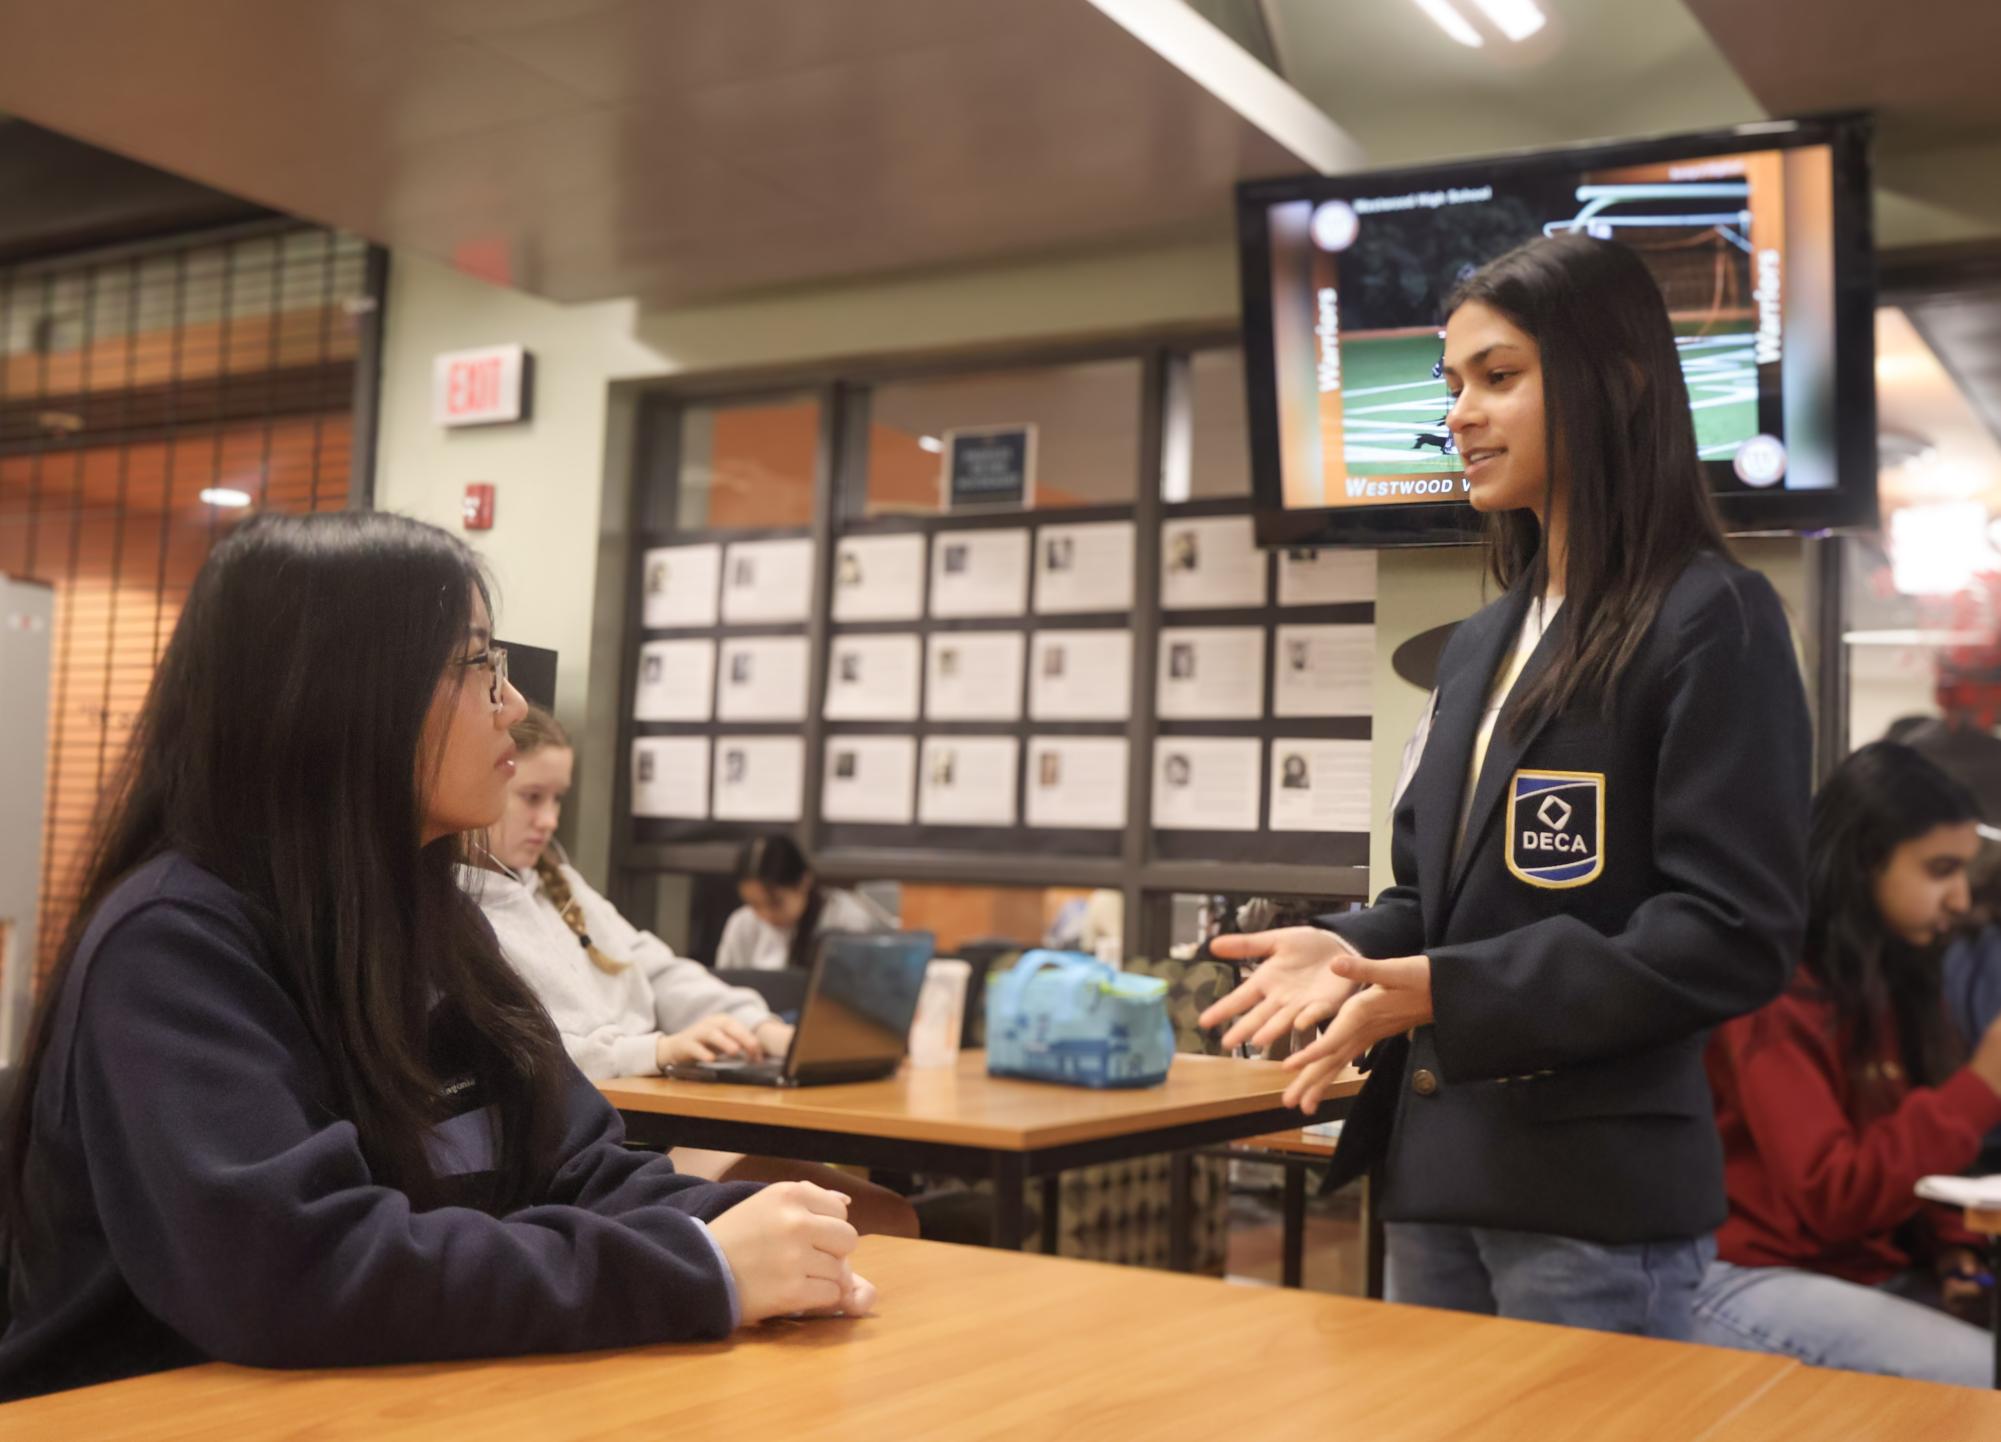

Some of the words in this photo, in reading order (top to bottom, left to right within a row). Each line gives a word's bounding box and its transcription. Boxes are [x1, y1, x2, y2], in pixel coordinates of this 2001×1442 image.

[1315, 287, 1340, 392] Warriors
[1752, 249, 1781, 364] Warriors
[447, 356, 502, 415] EXIT
[1522, 831, 1587, 853] DECA
